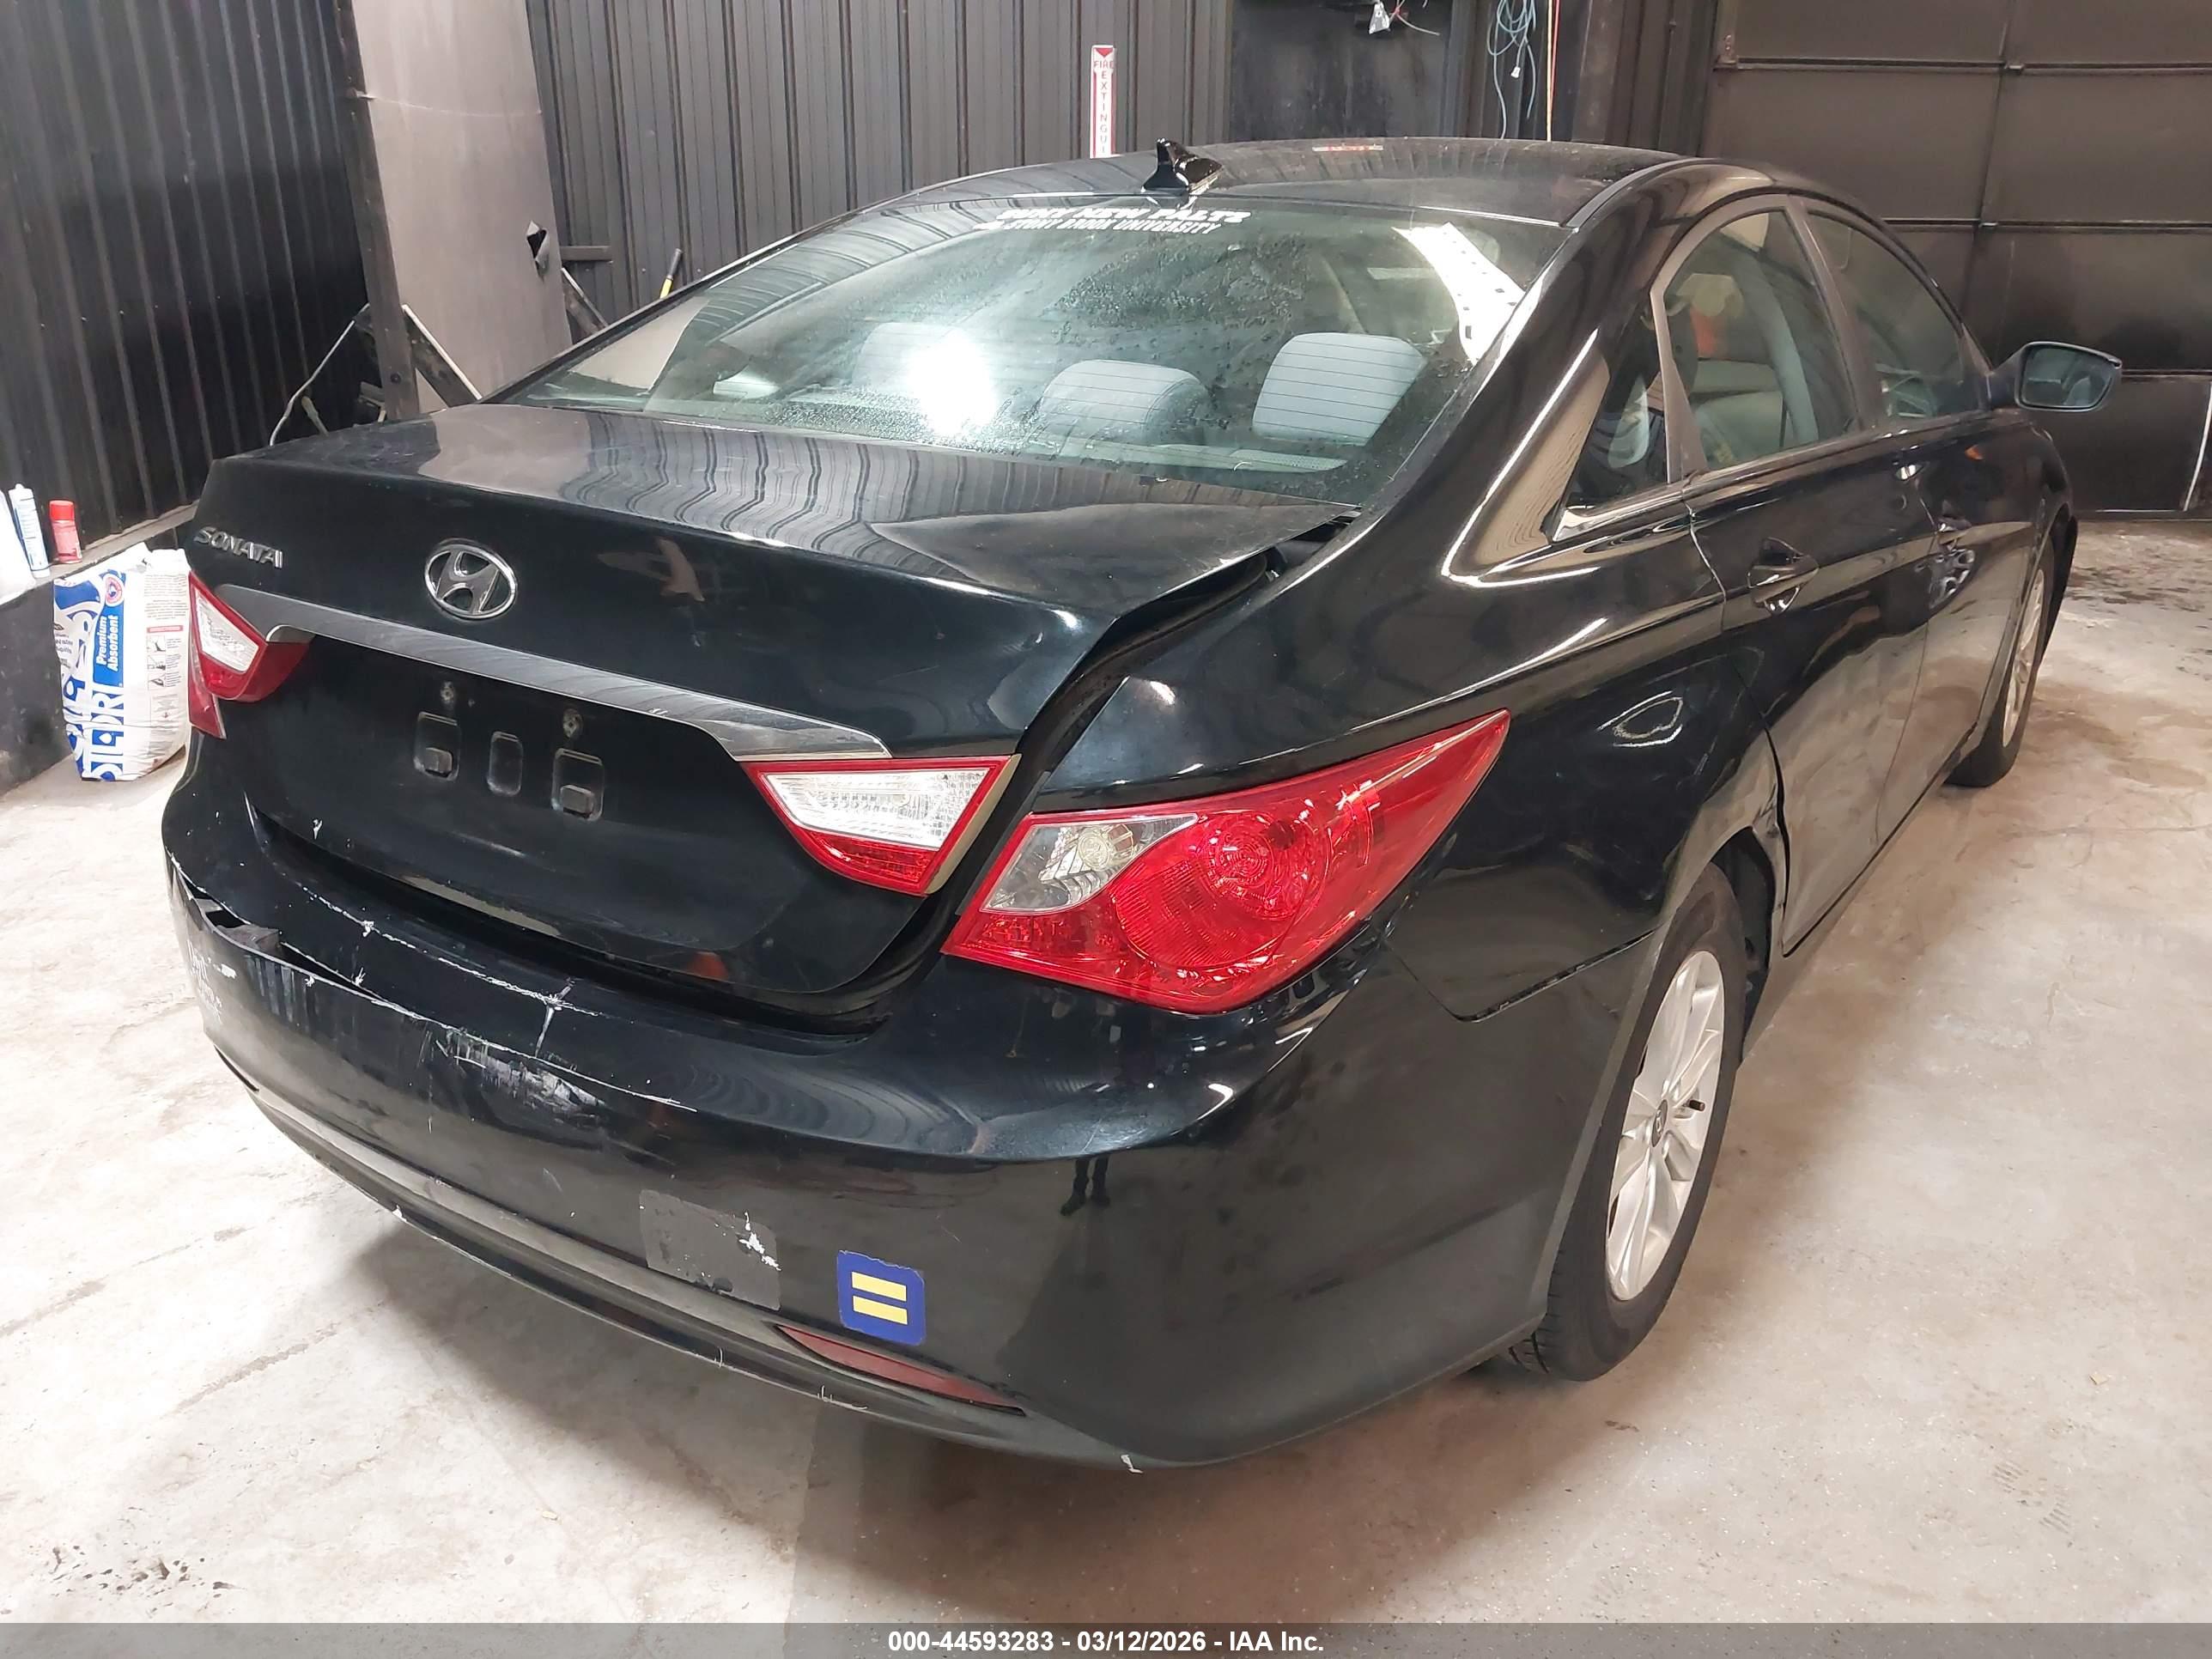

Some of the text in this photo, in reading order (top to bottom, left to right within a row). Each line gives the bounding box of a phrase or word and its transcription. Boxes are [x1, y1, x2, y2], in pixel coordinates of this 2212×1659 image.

[1093, 60, 1115, 70] FIRE
[1003, 218, 1222, 234] STONY BROOK UNIVERSITY
[1073, 208, 1151, 219] NEW
[193, 526, 283, 568] SONATA
[95, 616, 107, 665] Premium
[106, 614, 119, 672] Absorbent
